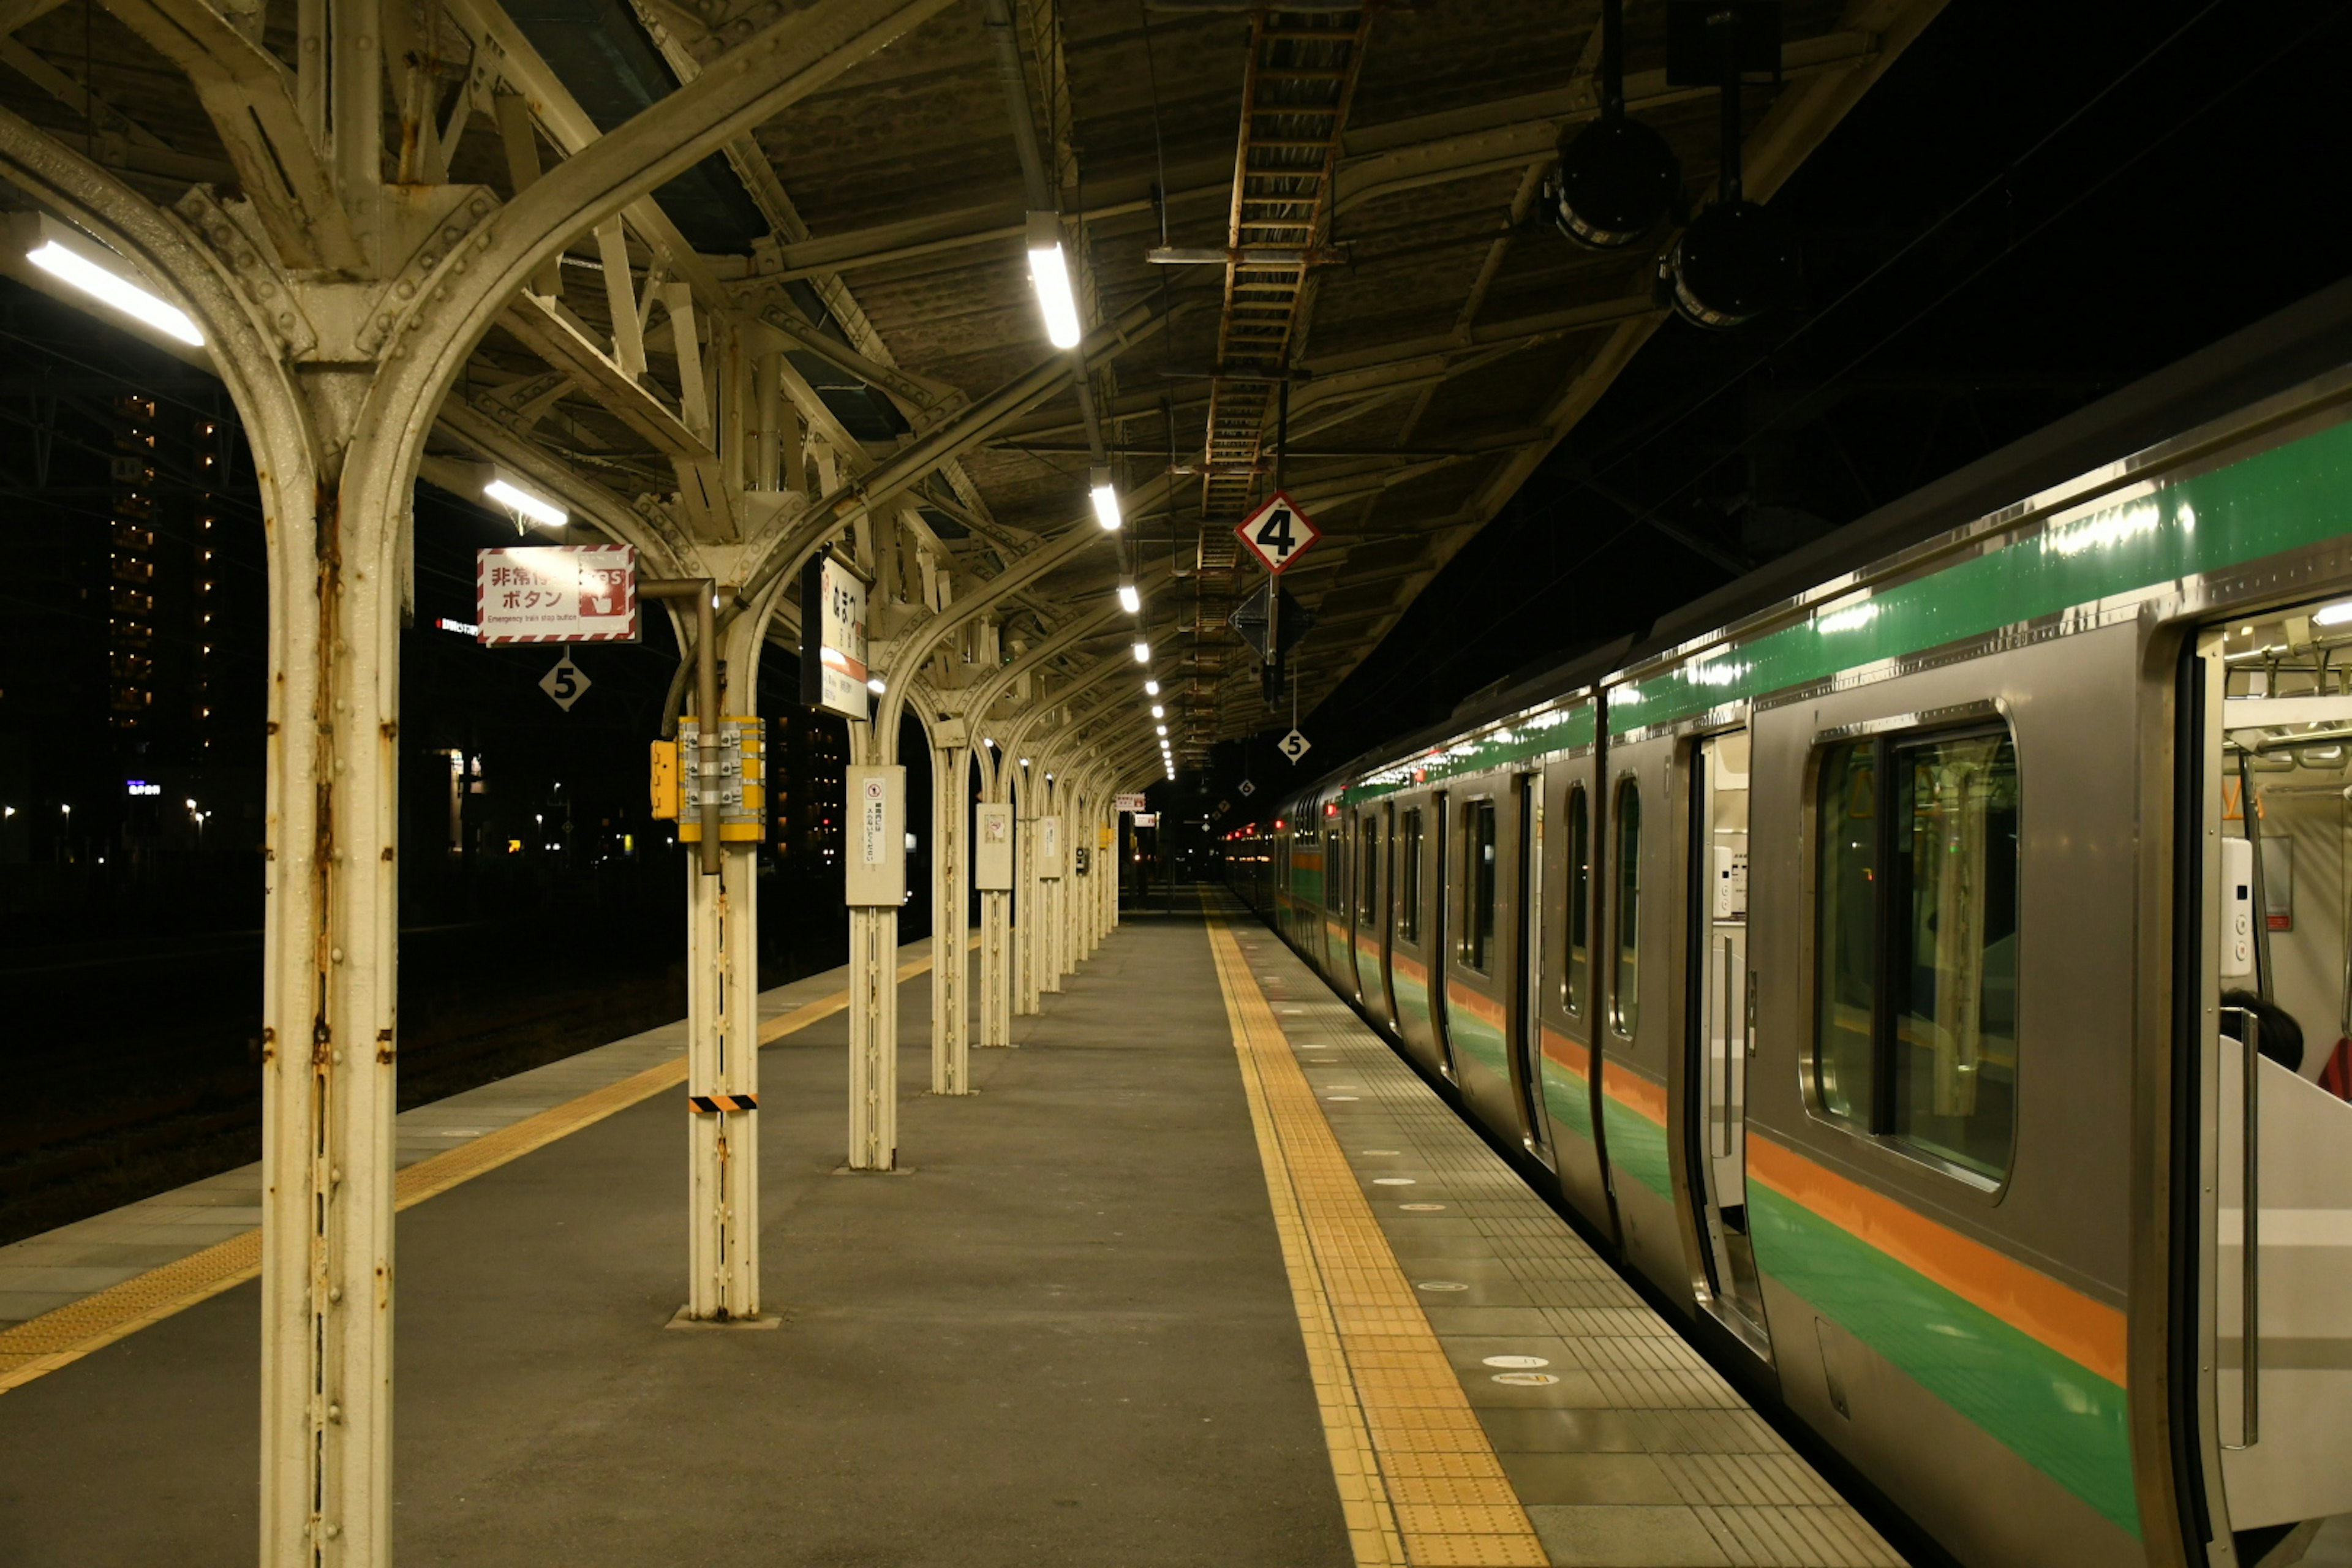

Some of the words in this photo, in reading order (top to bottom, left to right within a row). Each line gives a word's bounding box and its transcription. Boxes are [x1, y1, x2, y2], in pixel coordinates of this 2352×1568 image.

[1256, 510, 1295, 556] 4
[503, 590, 562, 609] ボタン
[554, 668, 577, 699] 5
[1287, 736, 1302, 756] 5
[1243, 782, 1251, 793] 6
